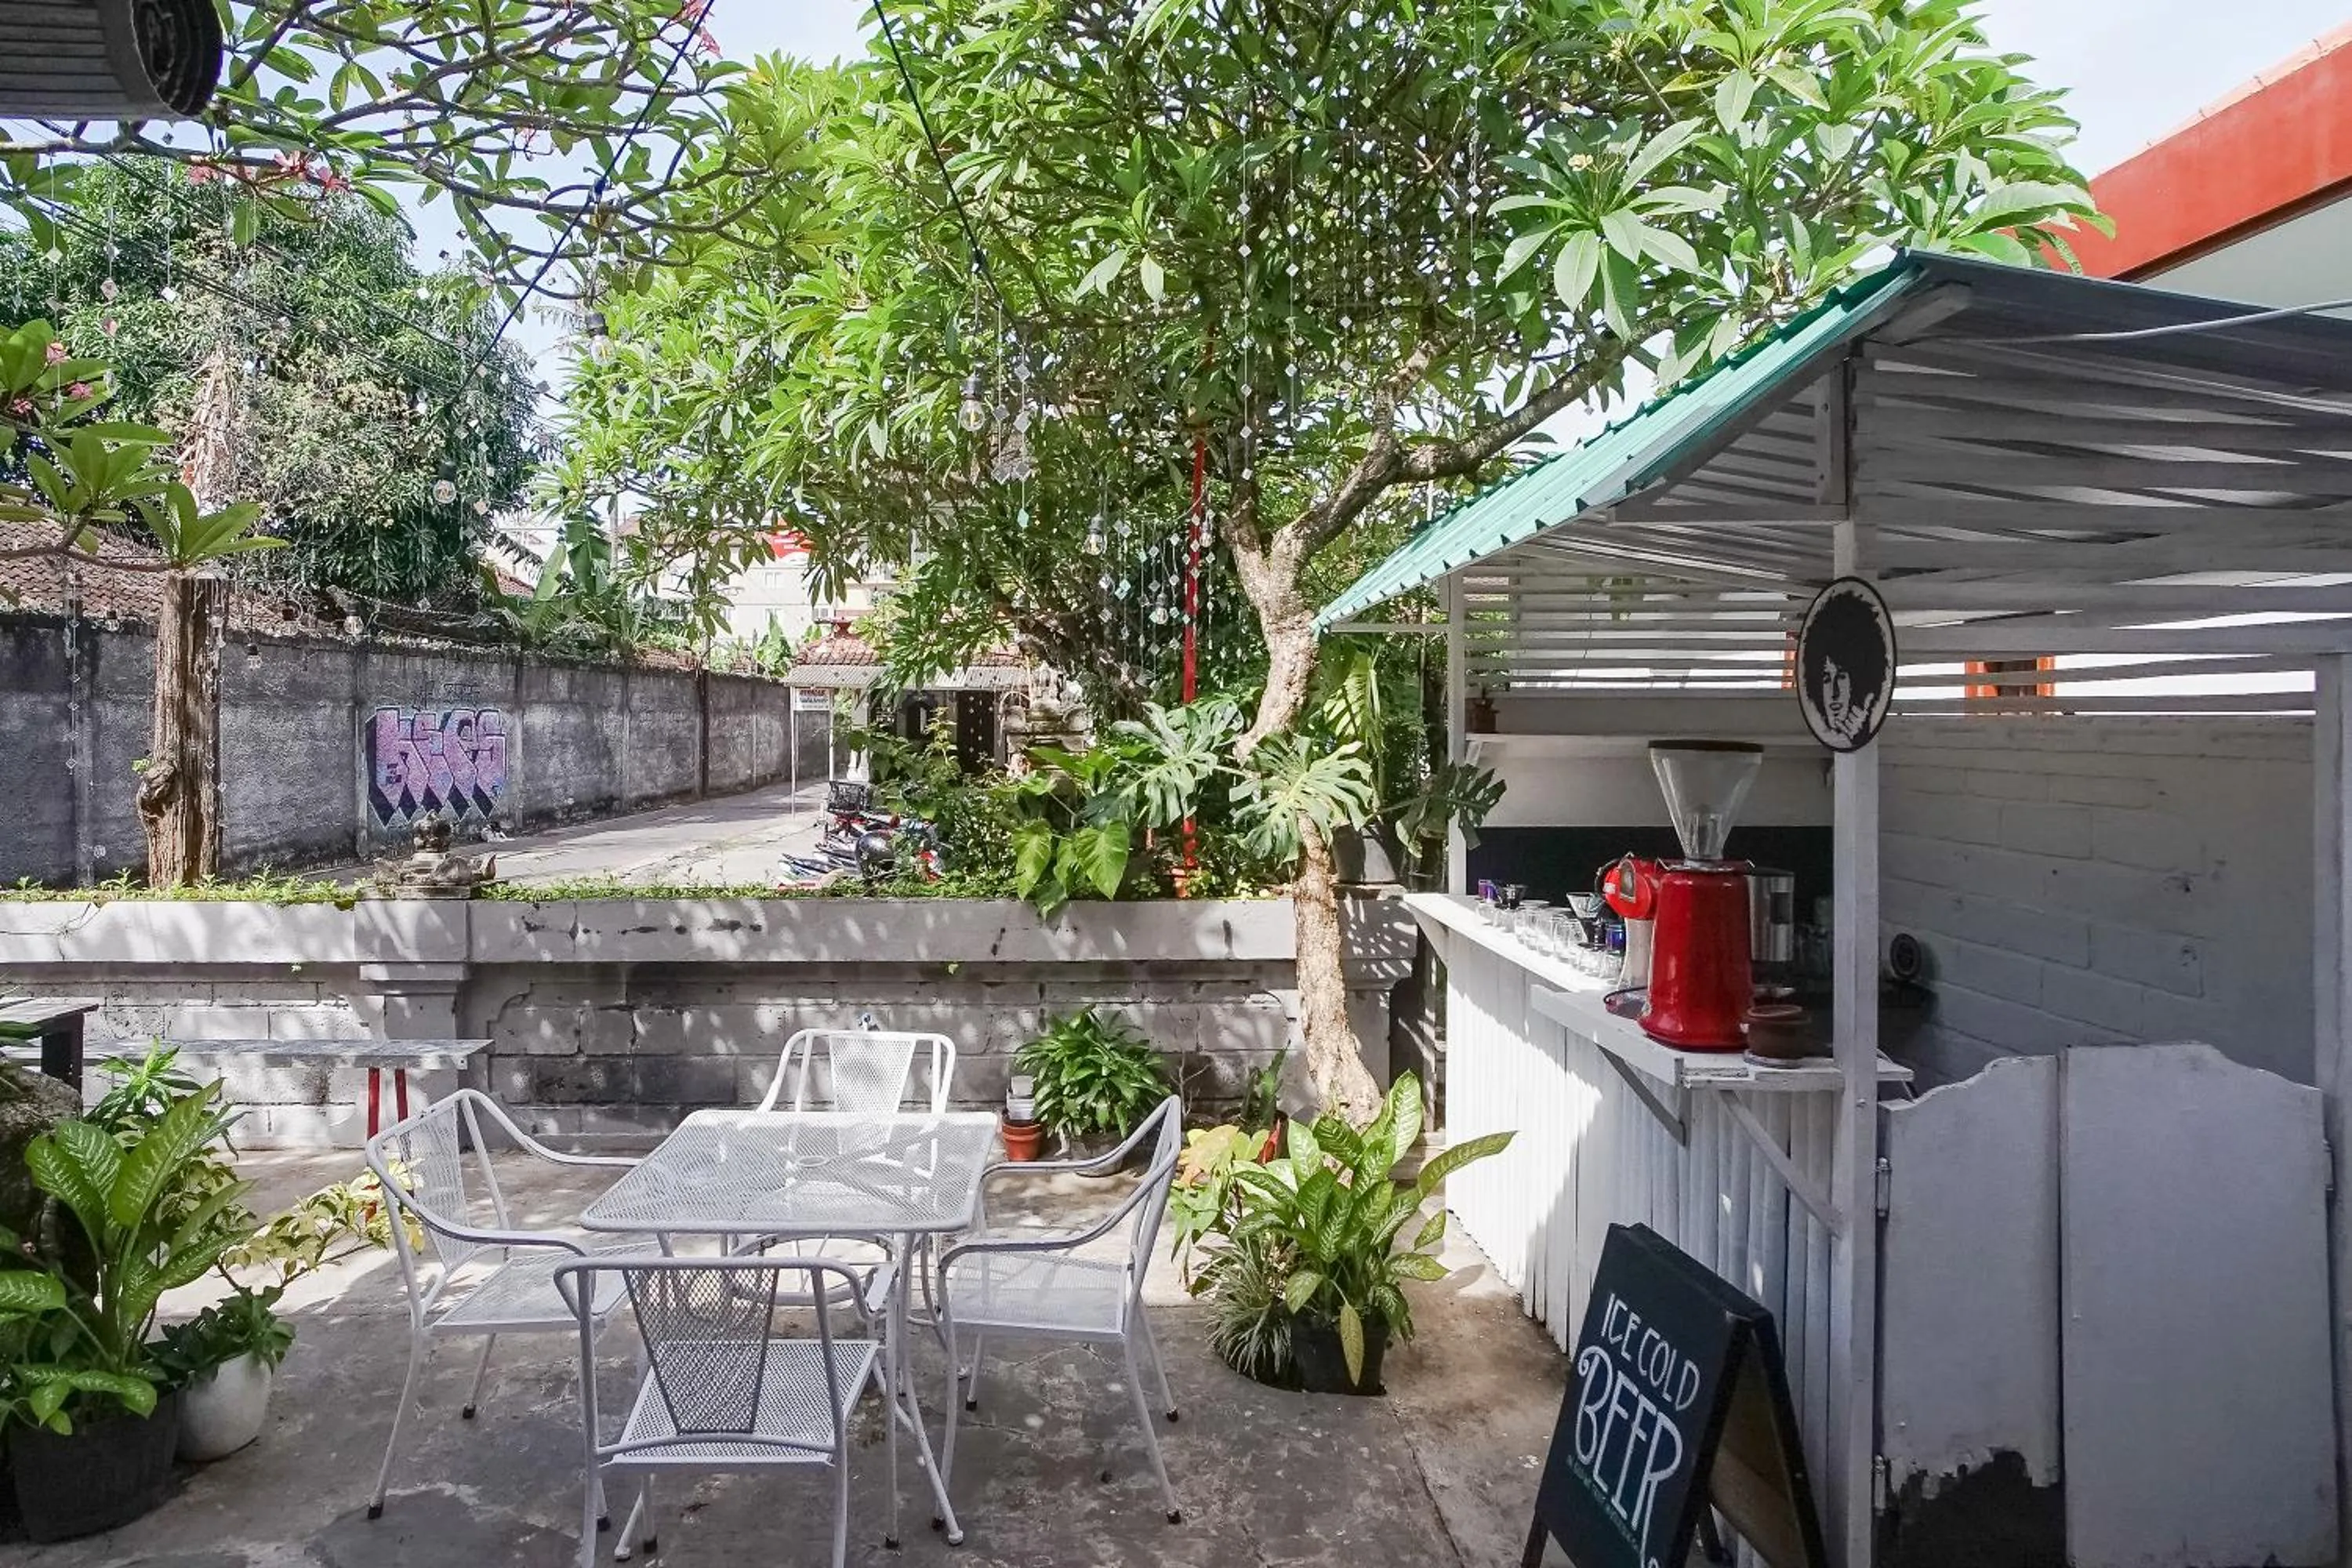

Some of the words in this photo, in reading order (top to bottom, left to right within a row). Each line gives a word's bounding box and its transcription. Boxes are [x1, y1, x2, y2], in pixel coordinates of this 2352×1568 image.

[1602, 1293, 1642, 1363] ICE
[1639, 1327, 1700, 1411] COLD
[1575, 1345, 1684, 1568] BEER
